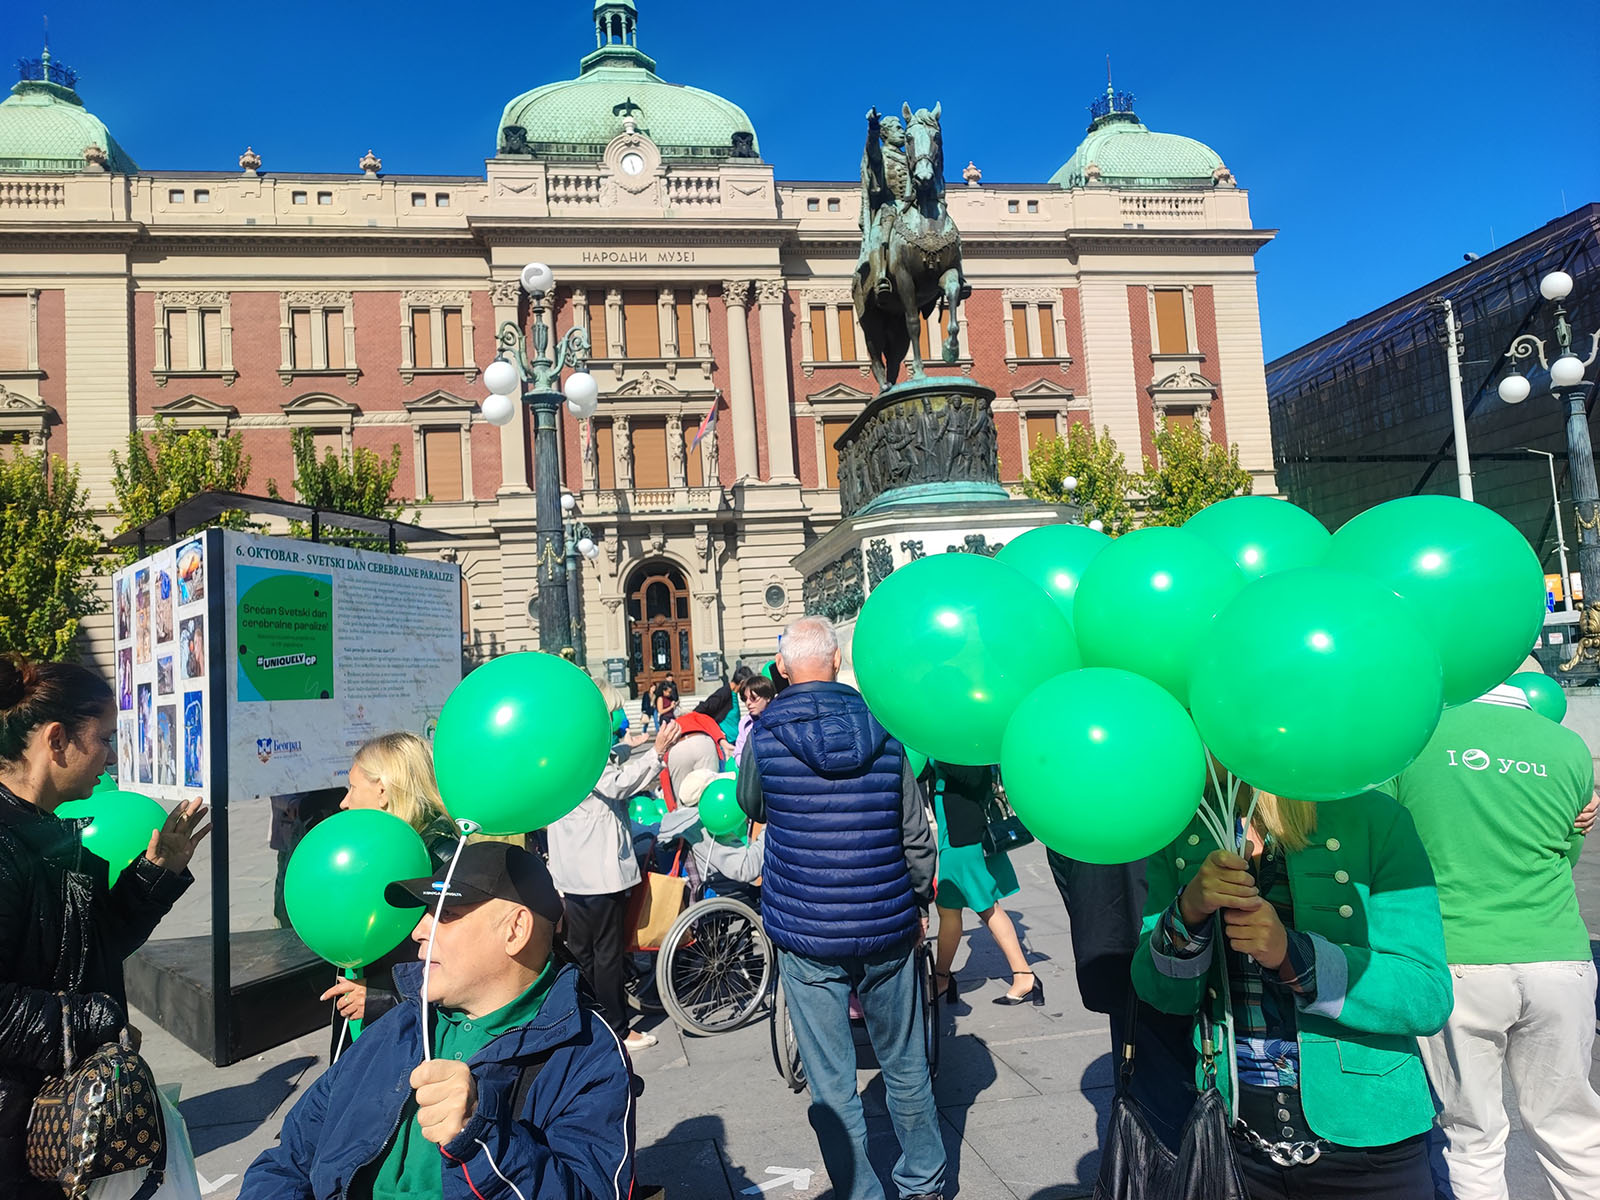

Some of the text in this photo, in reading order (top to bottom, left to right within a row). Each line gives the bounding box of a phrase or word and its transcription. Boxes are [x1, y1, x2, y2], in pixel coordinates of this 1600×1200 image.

[582, 251, 648, 263] НАРОДНИ
[236, 545, 245, 557] 6.
[247, 546, 299, 563] OKTOBAR
[307, 554, 345, 569] SVETSKI
[347, 559, 366, 572] DAN
[368, 562, 419, 579] CEREBRALNE
[420, 568, 455, 583] PARALIZE
[243, 603, 328, 618] Srećan Svetski dan
[242, 618, 292, 630] cerebralne
[1446, 750, 1548, 777] I you
